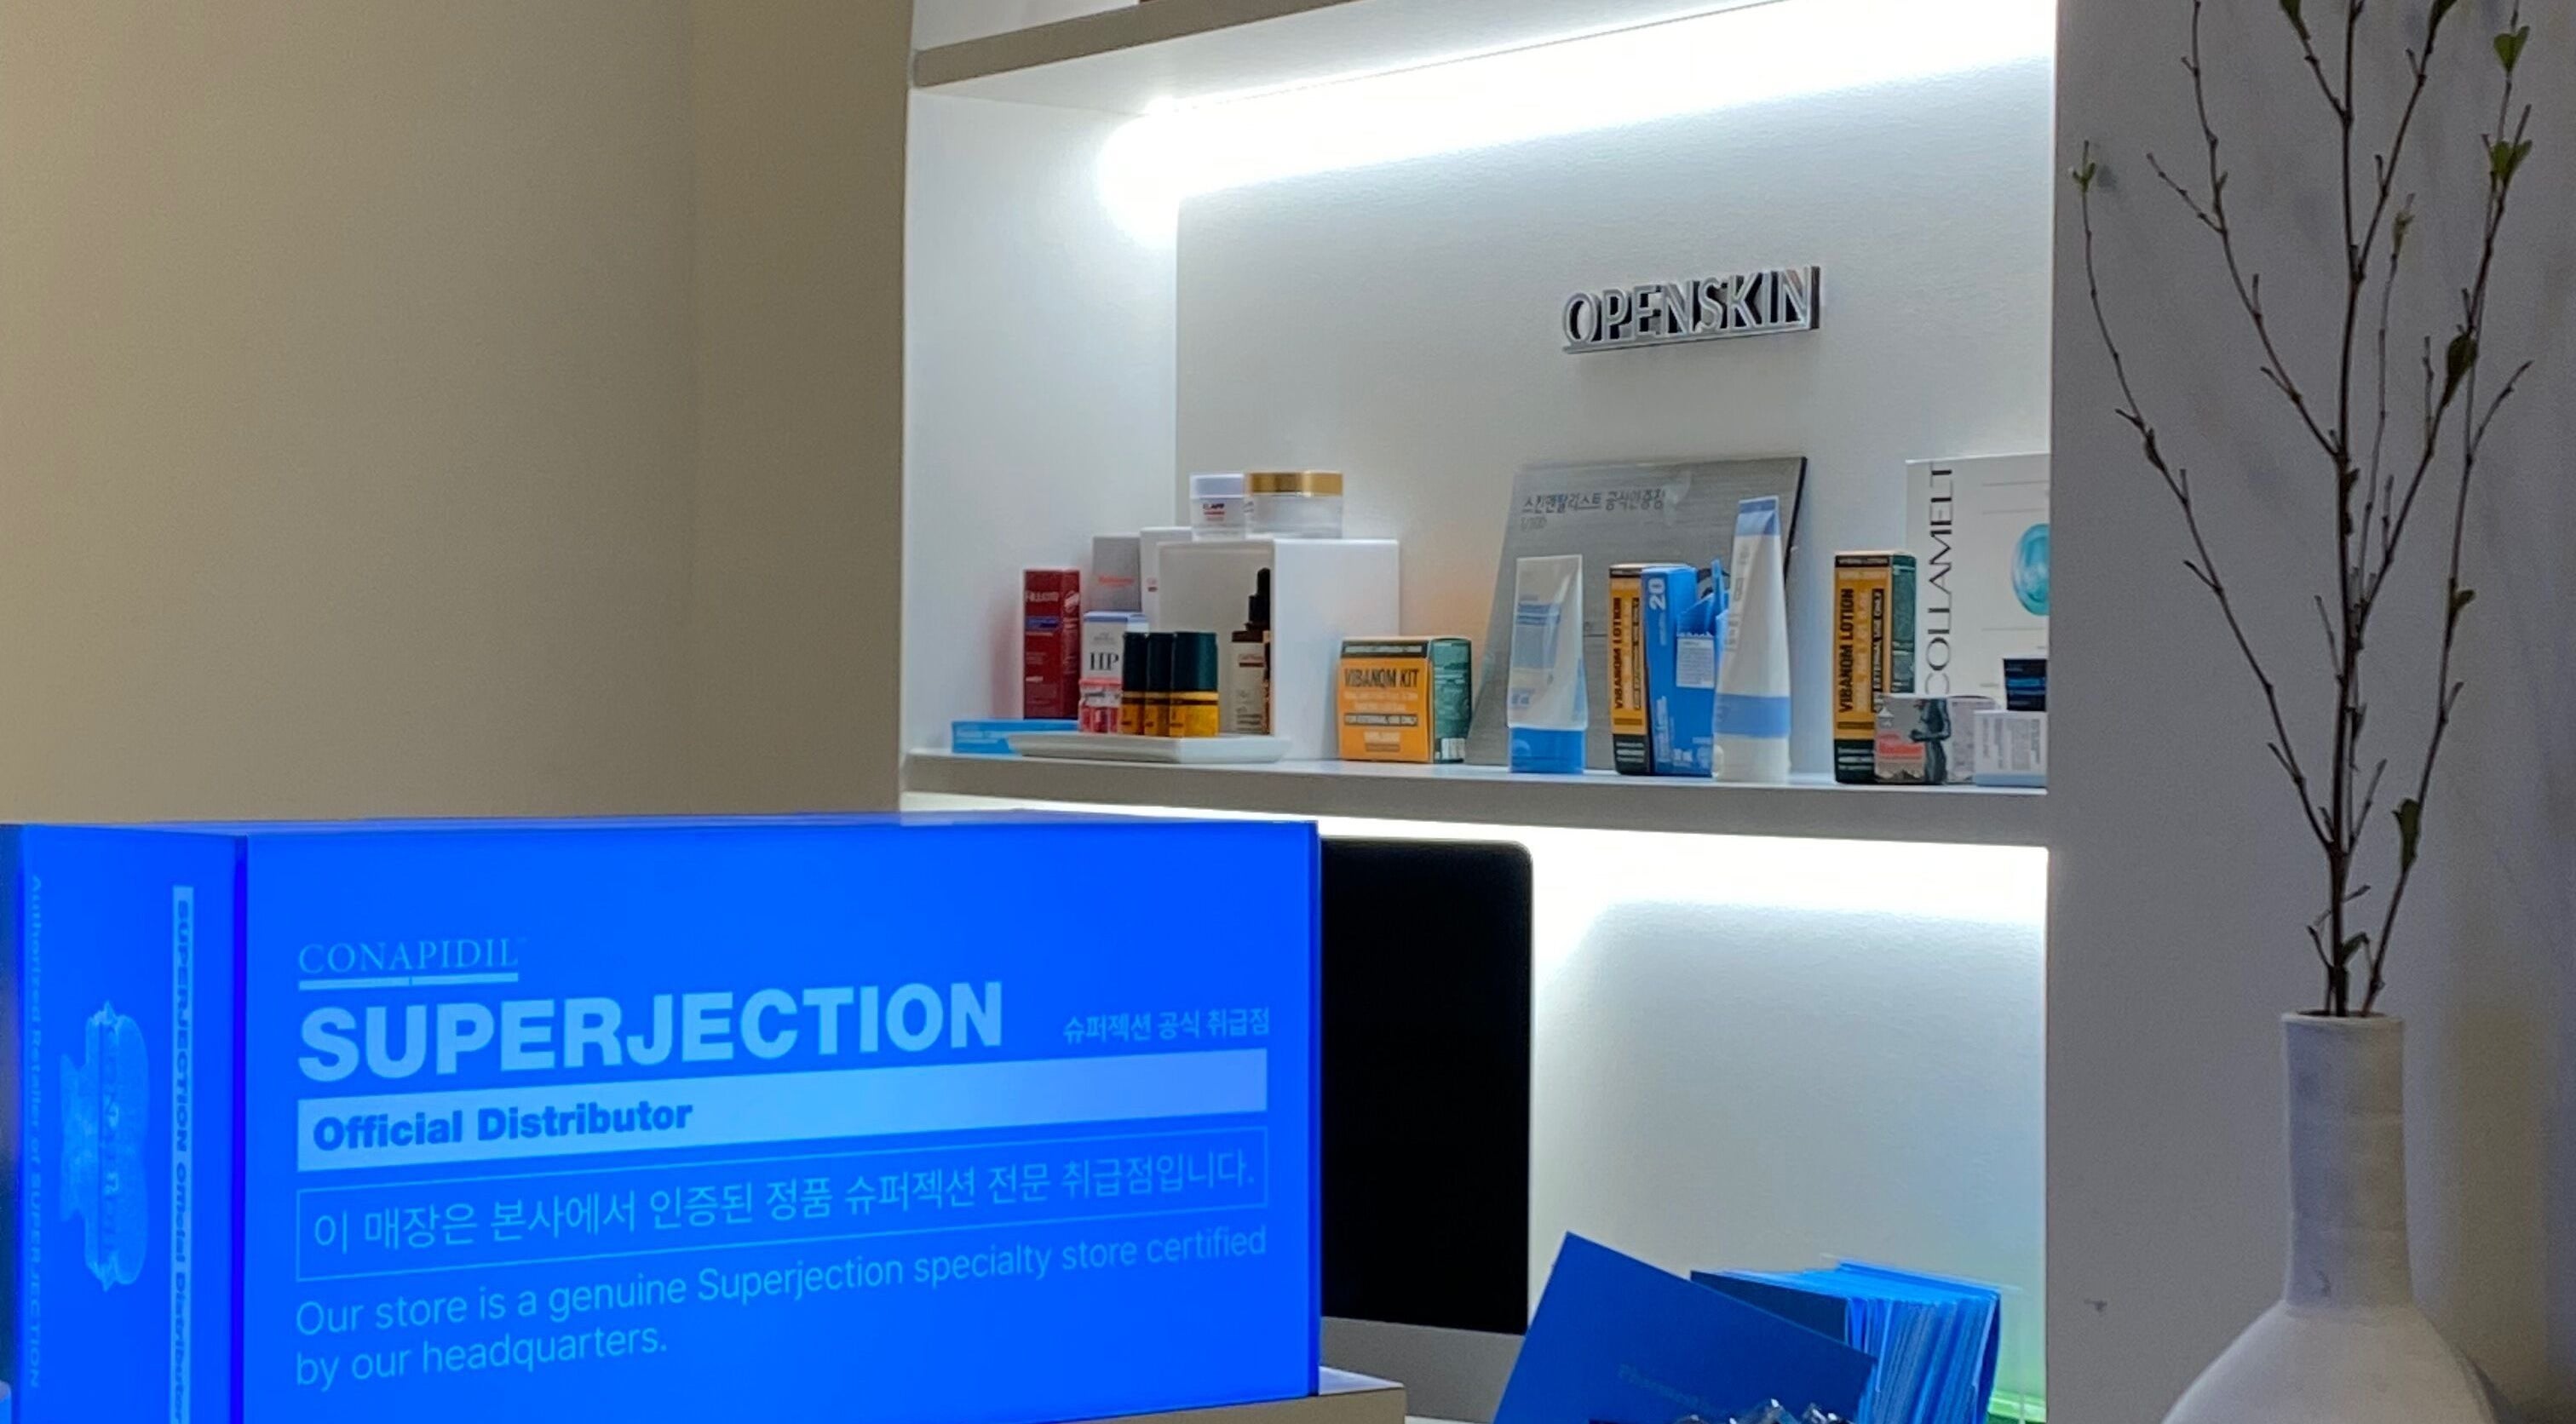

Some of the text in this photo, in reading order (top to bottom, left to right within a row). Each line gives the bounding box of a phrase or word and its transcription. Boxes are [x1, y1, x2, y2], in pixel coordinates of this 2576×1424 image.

[1562, 266, 1820, 345] OPENSKIN
[1648, 577, 1666, 611] 20
[1924, 461, 1952, 695] COLLAMELT
[1839, 589, 1854, 640] LOTION
[1090, 652, 1119, 671] HP
[1400, 668, 1419, 687] KIT
[175, 900, 189, 1152] SUPERJECTION
[298, 981, 1003, 1082] SUPERJECTION
[1063, 1007, 1270, 1045] 슈퍼젝션 공식 취급점
[313, 1100, 693, 1151] Official Distributor
[314, 1149, 1256, 1255] 이 매장은 본사에서 인증된 정품 슈퍼젝션 전문 취급점입니다.
[29, 1171, 41, 1389] SUPERJECTION
[296, 1224, 1267, 1335] Our store is a genuine Superjection specialty store certified
[296, 1327, 667, 1392] by our headquarters.
